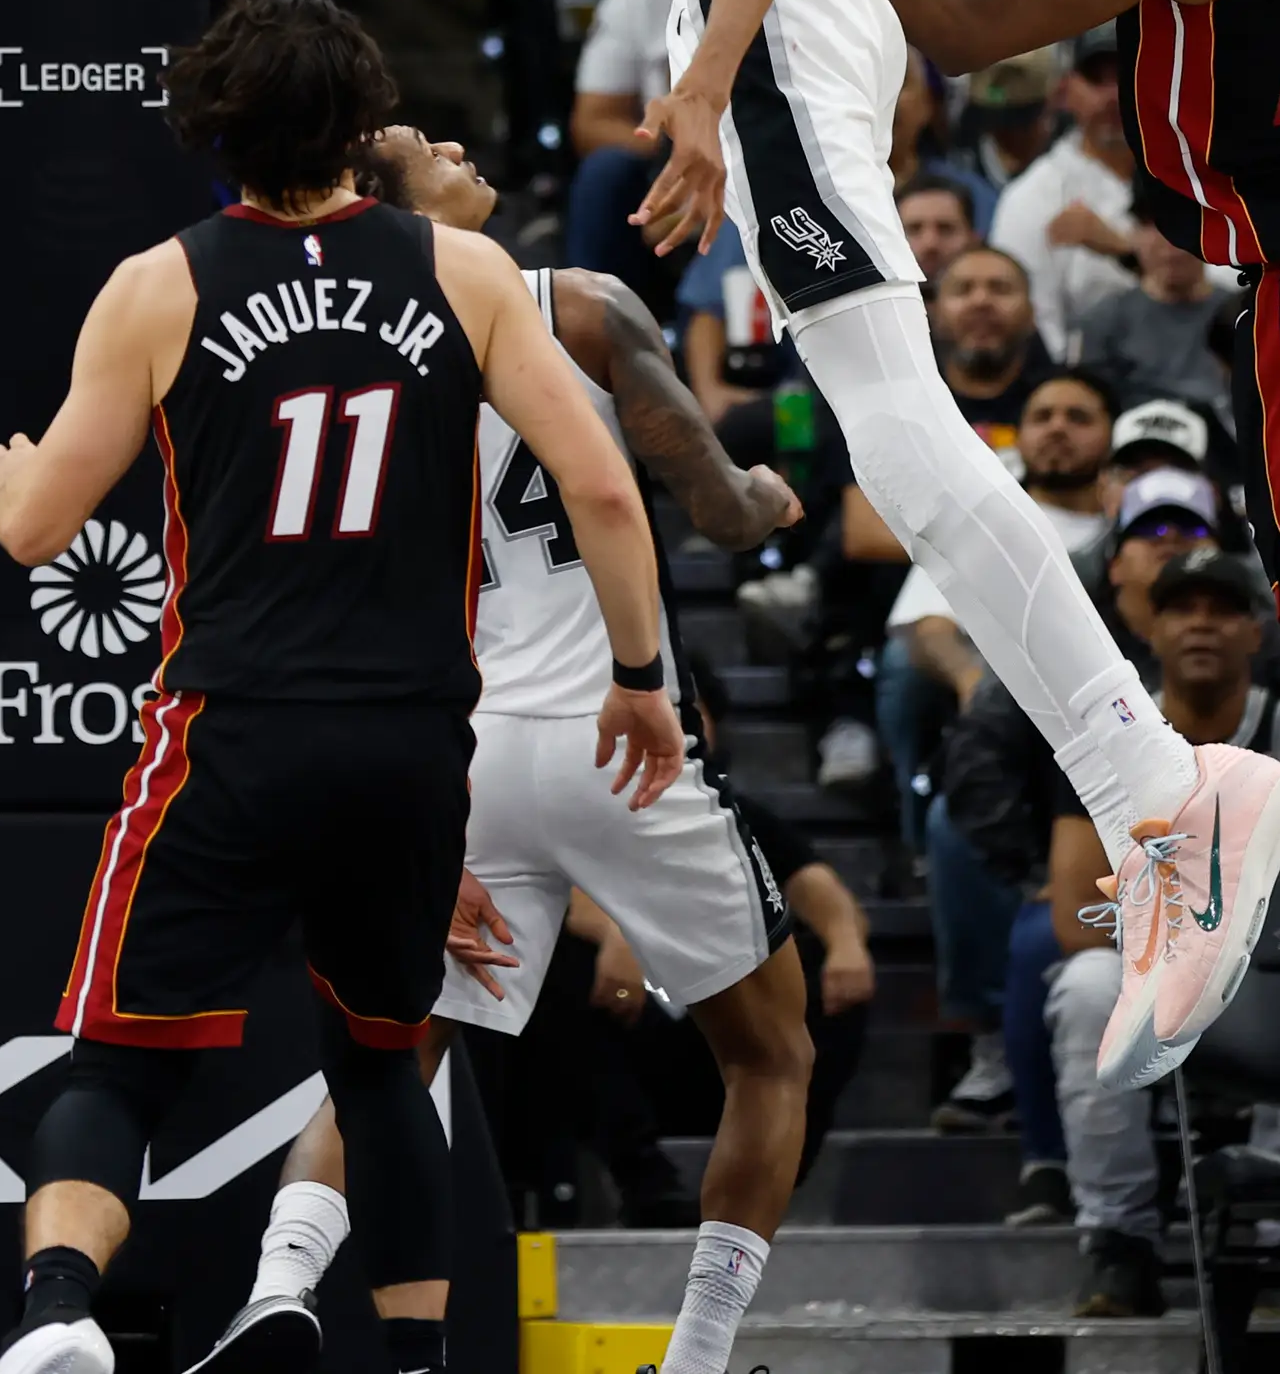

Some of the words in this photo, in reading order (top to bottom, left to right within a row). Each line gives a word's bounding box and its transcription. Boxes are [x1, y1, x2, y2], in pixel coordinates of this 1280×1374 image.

[19, 62, 146, 93] LEDGER
[200, 277, 373, 383] JAQUEZ
[378, 297, 445, 378] JR.
[264, 380, 402, 544] 11
[478, 432, 586, 594] 4
